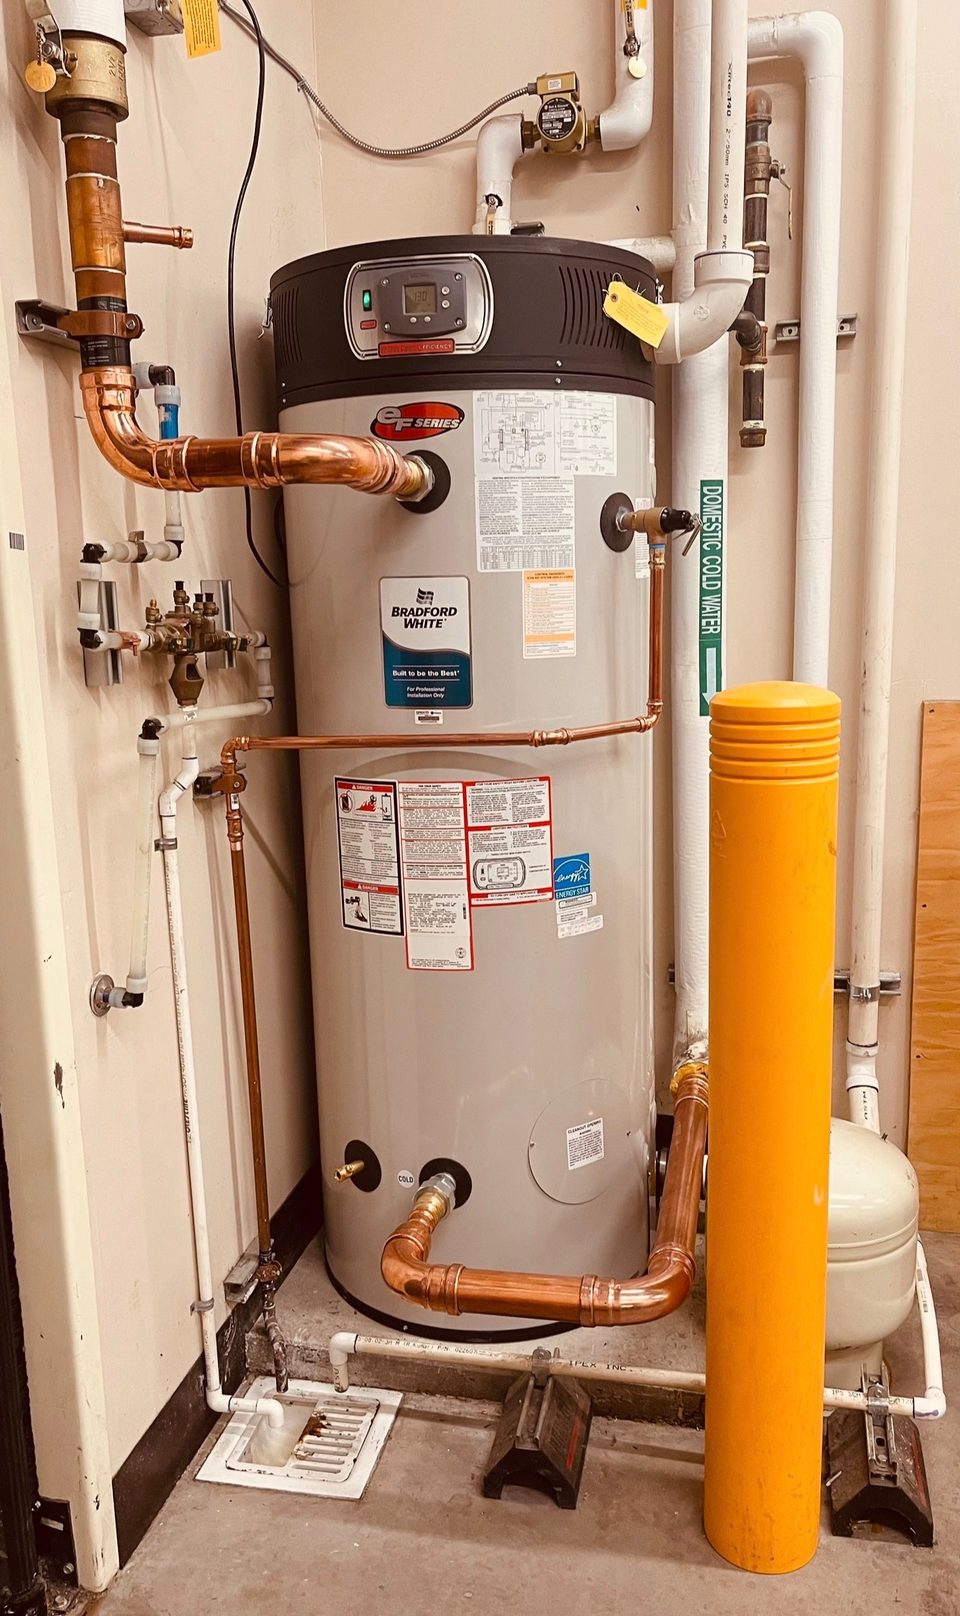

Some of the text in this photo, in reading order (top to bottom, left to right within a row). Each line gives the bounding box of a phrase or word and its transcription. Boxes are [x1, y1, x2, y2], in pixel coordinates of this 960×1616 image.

[722, 214, 728, 225] 40
[414, 417, 460, 429] SERIES
[701, 485, 722, 634] DOMESTIC COLD WATER
[391, 606, 458, 618] BRADFORD
[403, 618, 444, 629] WHITE
[556, 886, 590, 899] ENERGY STAR
[398, 1175, 414, 1184] COLD
[568, 1360, 633, 1373] IPEX INC.
